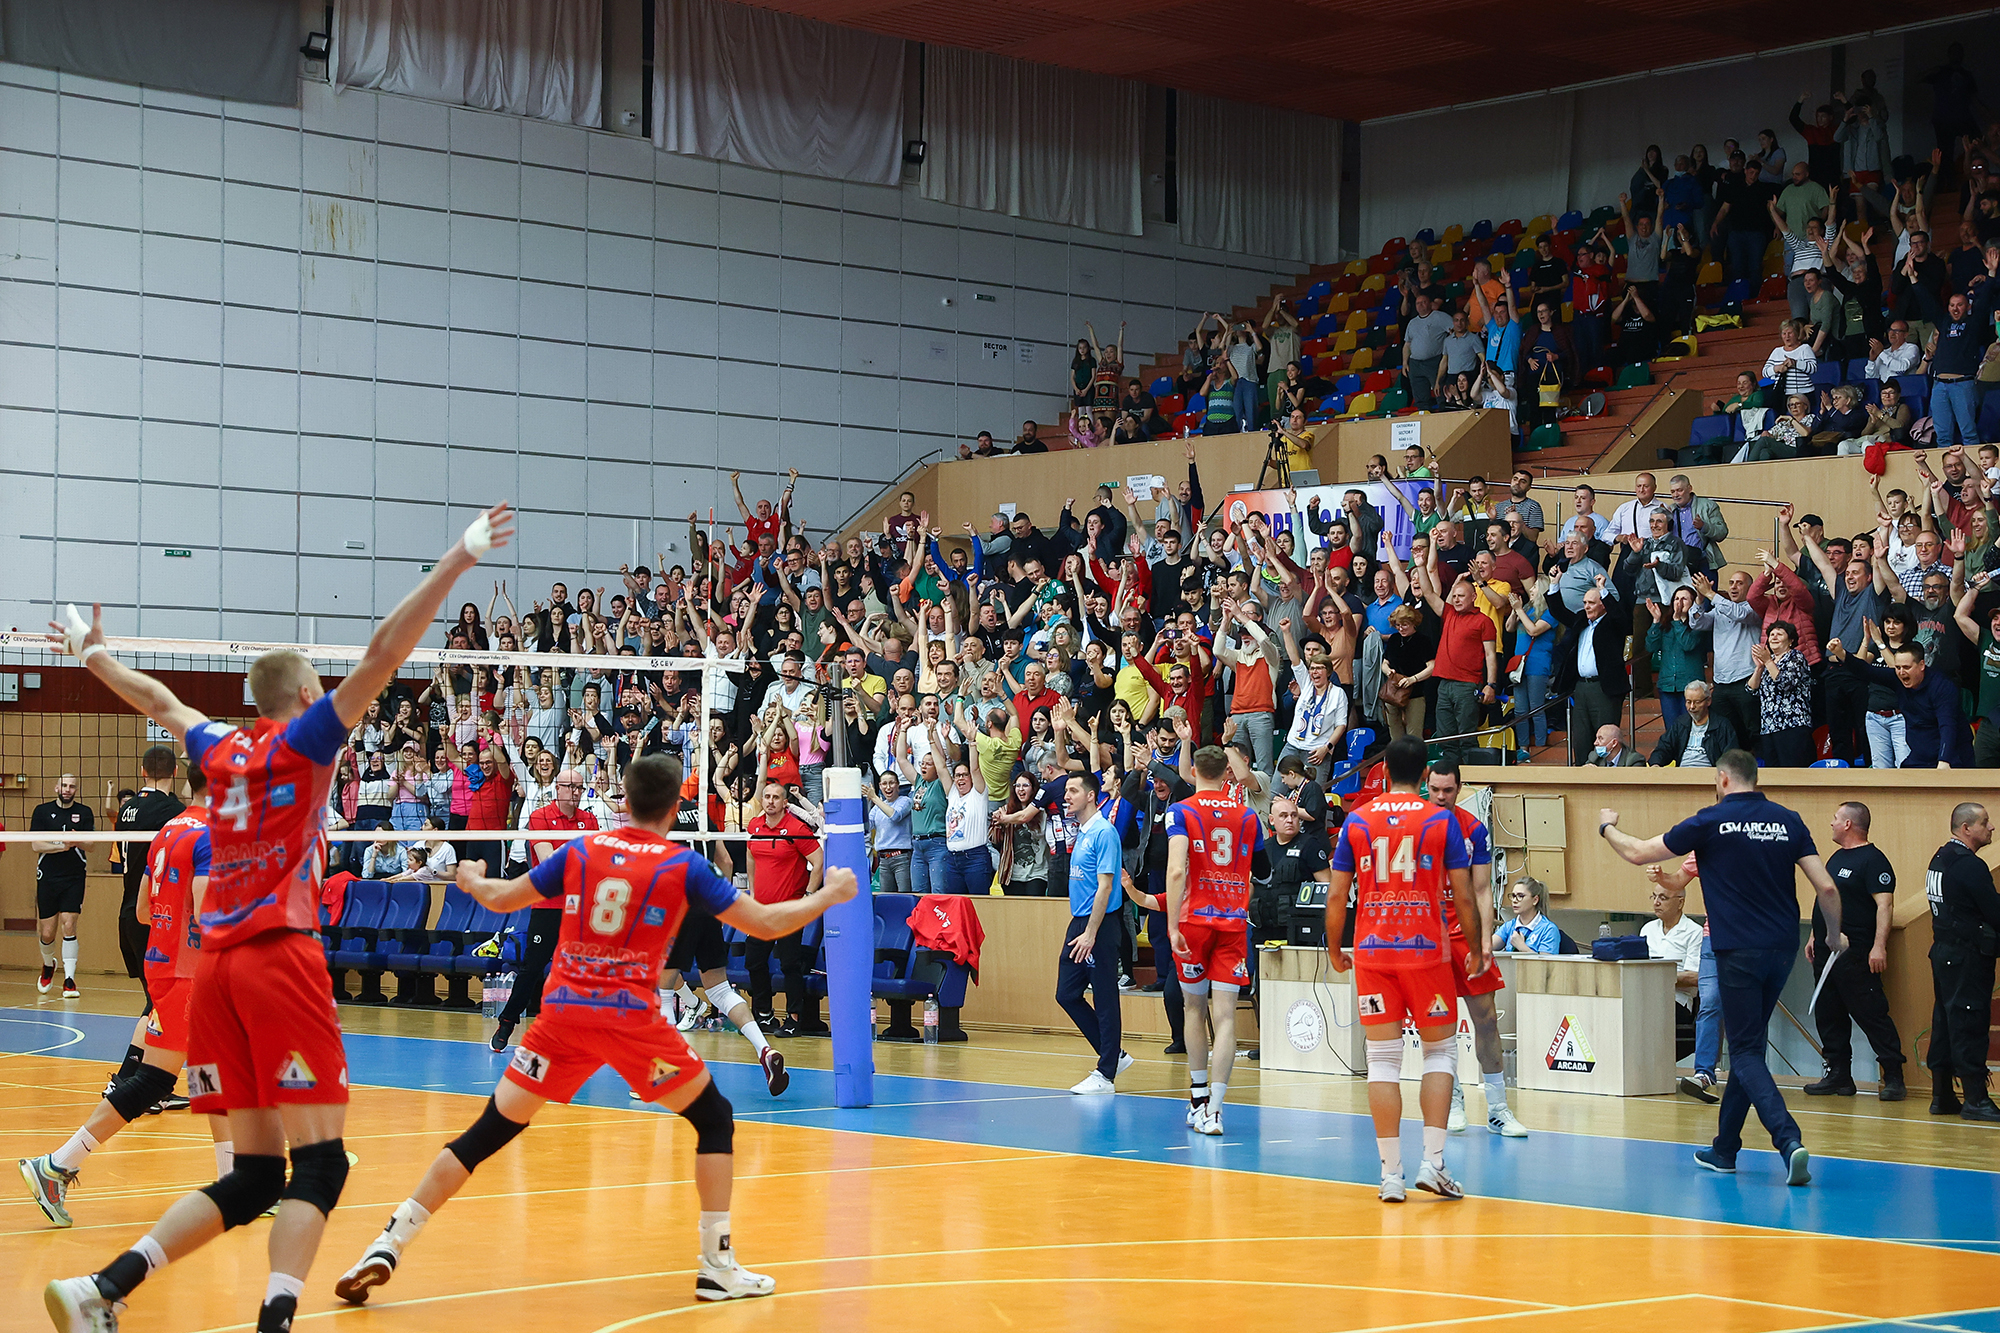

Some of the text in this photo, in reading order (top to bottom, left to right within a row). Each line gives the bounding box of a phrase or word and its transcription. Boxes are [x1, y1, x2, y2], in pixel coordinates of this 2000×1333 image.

[984, 342, 1008, 351] SECTOR
[993, 351, 998, 359] F
[161, 729, 168, 739] C
[217, 774, 252, 832] 4
[1198, 798, 1238, 809] WOCH
[1370, 801, 1424, 812] JAVAD
[1719, 822, 1787, 835] CSM ARCADA
[593, 834, 667, 854] GERGYE
[1211, 827, 1233, 866] 3
[1371, 835, 1416, 883] 14
[1300, 885, 1311, 903] 0
[1364, 890, 1430, 907] ARCADA
[589, 876, 632, 936] 8
[1548, 1026, 1567, 1057] GALATI
[1569, 1018, 1592, 1060] ROMANIA
[1557, 1061, 1587, 1072] ARCADA
